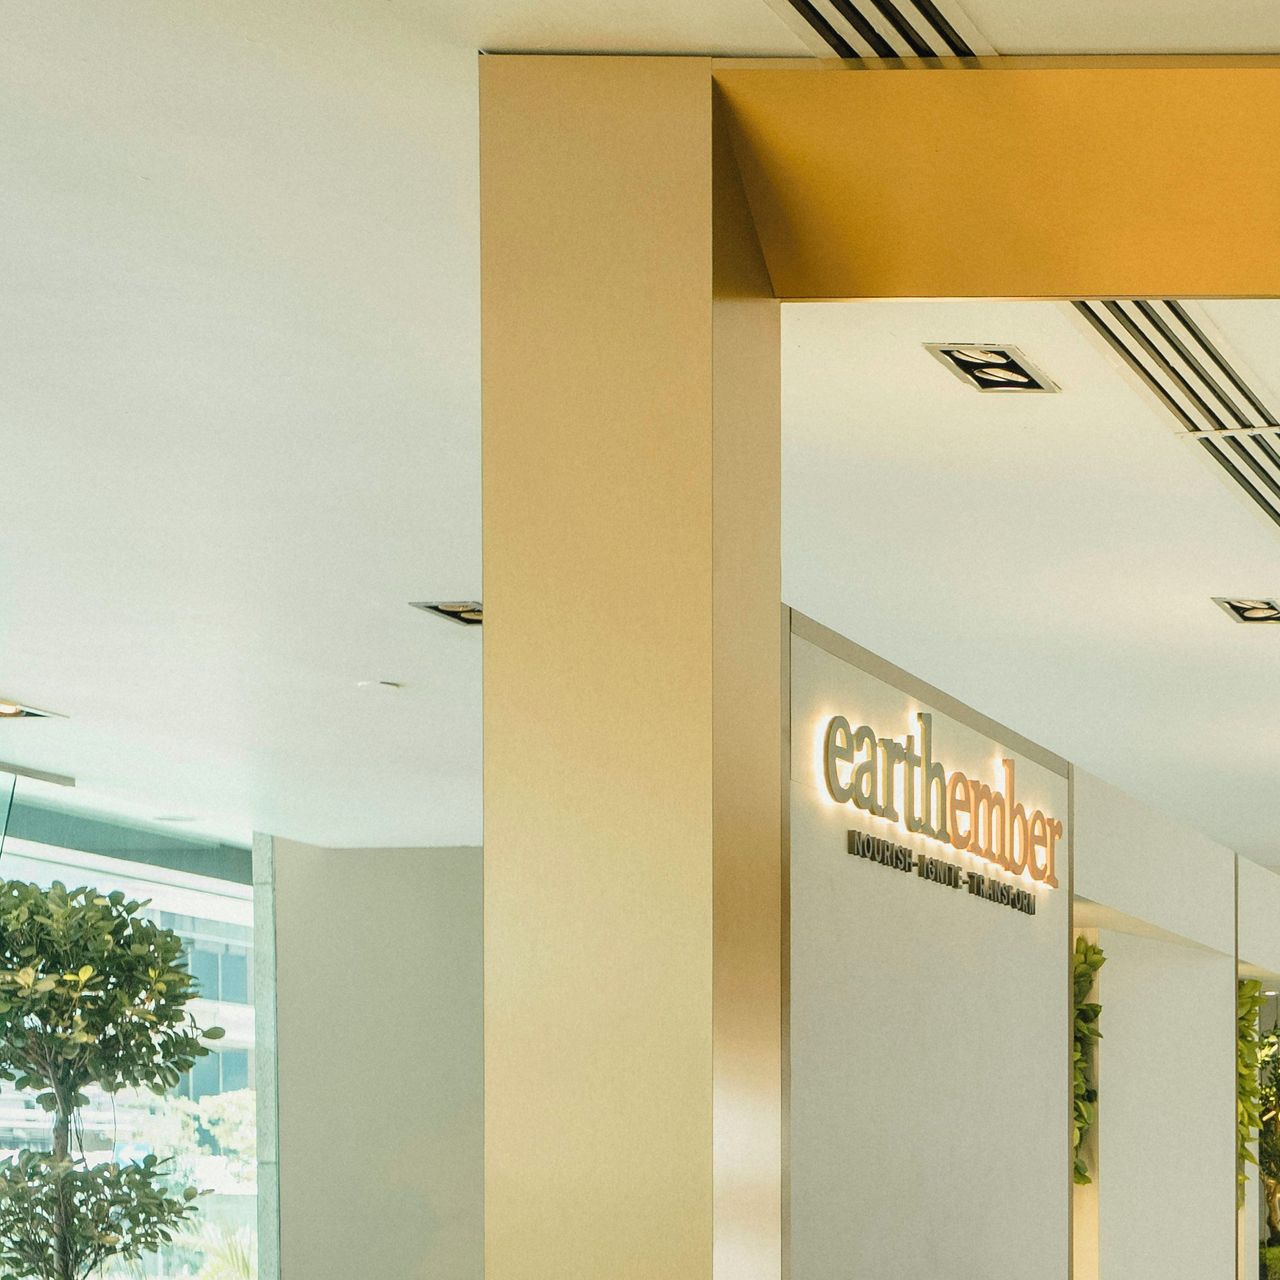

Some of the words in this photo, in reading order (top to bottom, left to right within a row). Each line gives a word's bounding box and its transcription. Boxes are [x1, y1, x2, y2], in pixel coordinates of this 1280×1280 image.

[824, 712, 1063, 889] earthember
[848, 830, 912, 872] NOURISH
[918, 854, 962, 889] IGNITE
